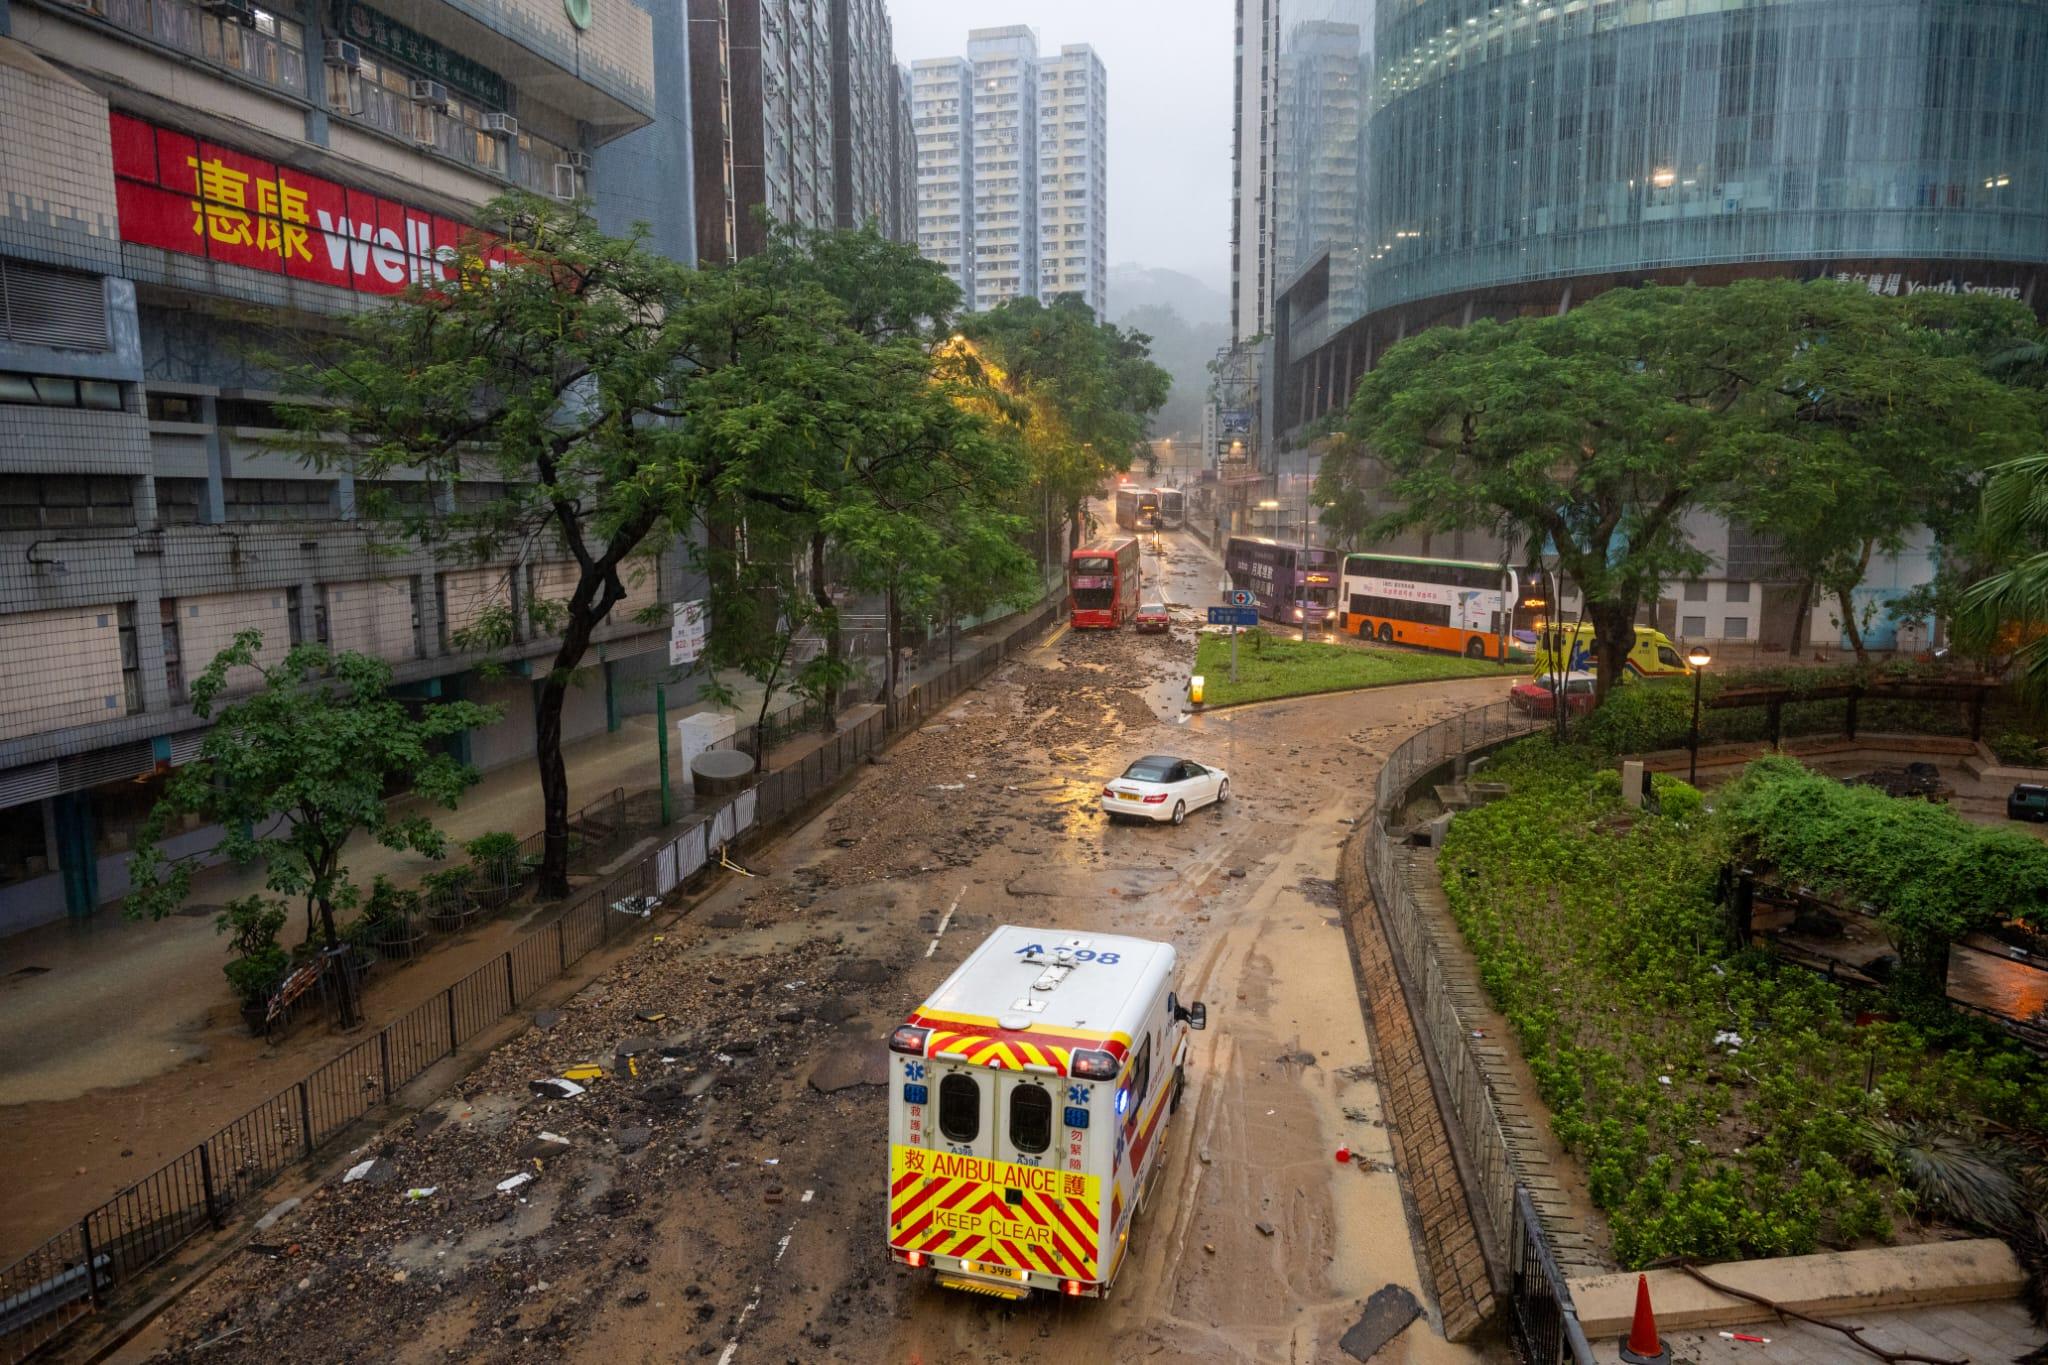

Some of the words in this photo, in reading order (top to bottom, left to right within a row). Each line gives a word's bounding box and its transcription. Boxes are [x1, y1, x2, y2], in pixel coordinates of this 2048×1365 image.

[187, 155, 313, 263] 惠康
[1014, 943, 1121, 965] A98
[910, 1105, 921, 1145] 救護車
[951, 1146, 974, 1157] A398
[1016, 1156, 1040, 1167] A398
[904, 1148, 925, 1171] 救
[932, 1154, 1056, 1193] AMBULANCE
[1063, 1173, 1086, 1197] 護
[935, 1210, 982, 1232] KEEP
[989, 1219, 1051, 1245] CLEAR
[990, 1266, 1013, 1278] 398
